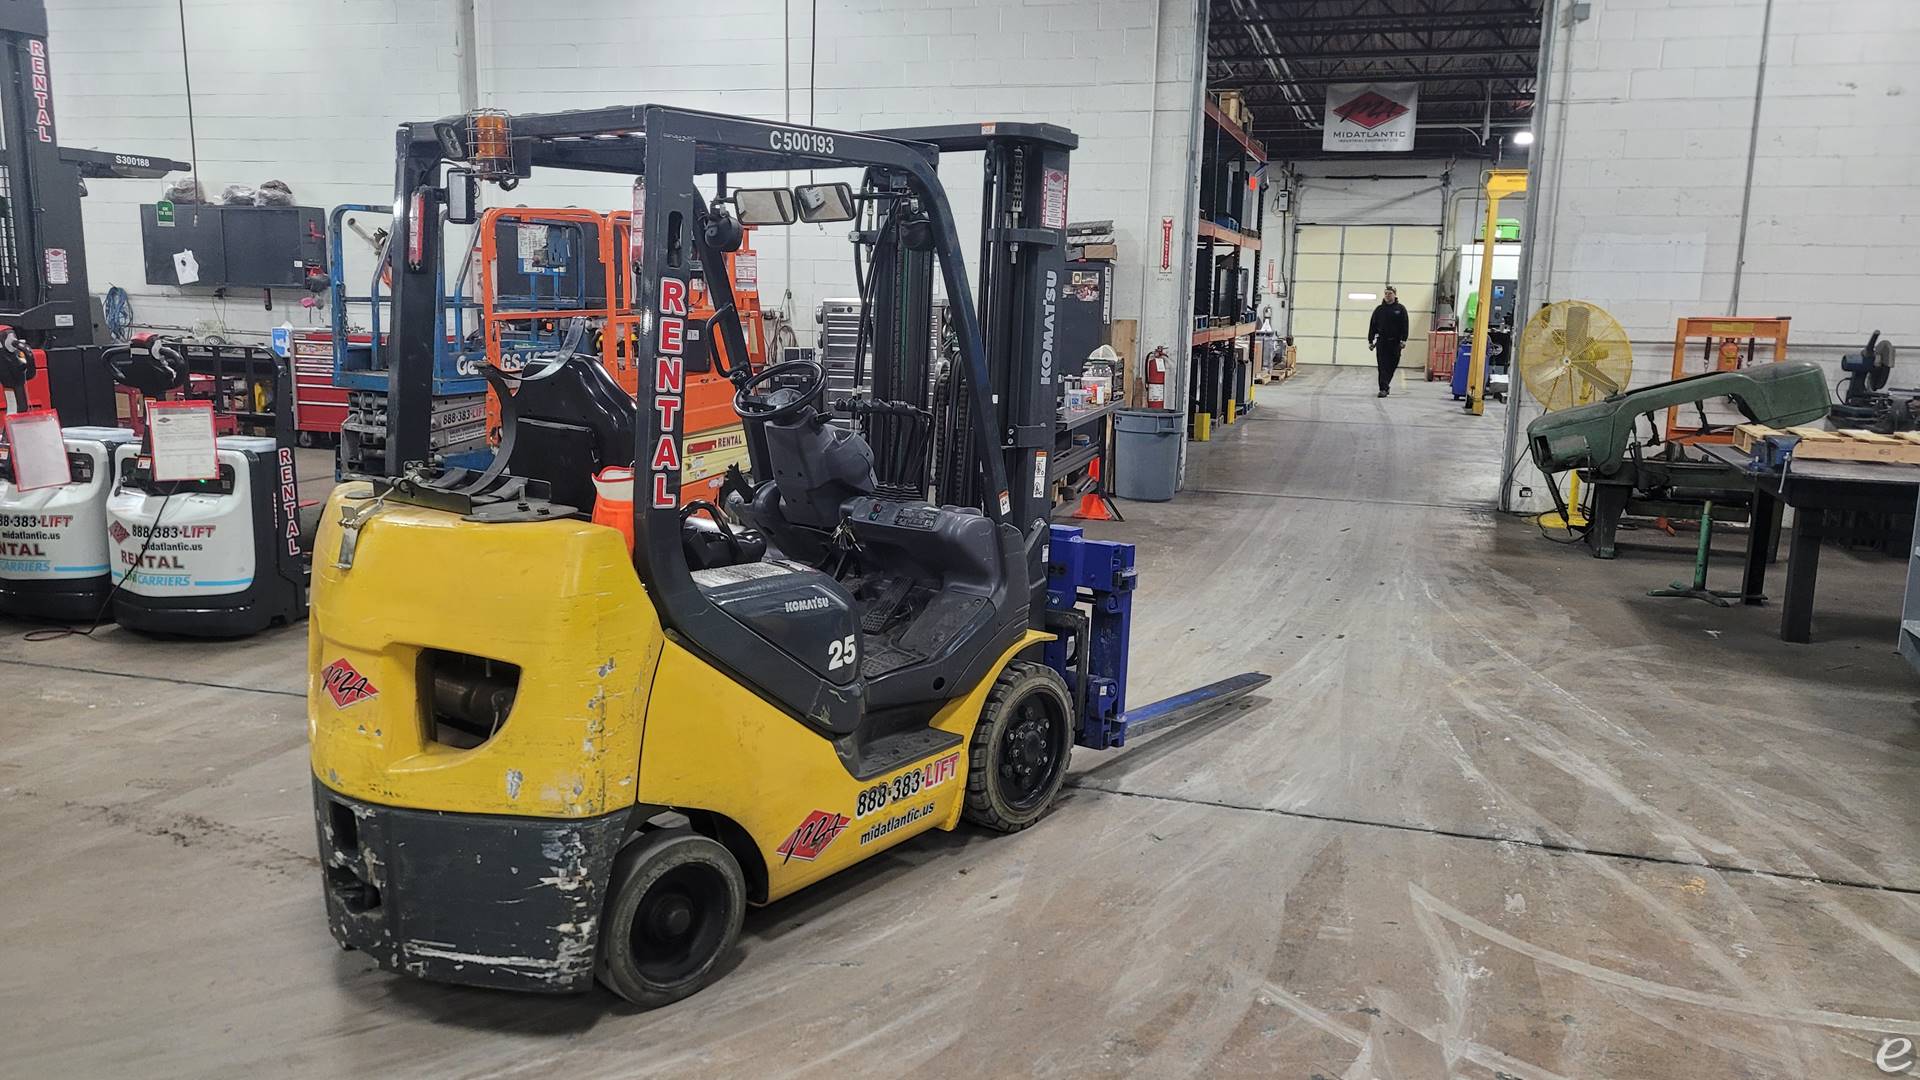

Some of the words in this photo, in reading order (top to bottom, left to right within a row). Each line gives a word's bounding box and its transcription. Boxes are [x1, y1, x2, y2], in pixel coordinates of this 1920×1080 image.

[29, 39, 52, 142] RENTAL
[770, 130, 835, 154] C500193
[1040, 270, 1058, 385] KOMATSU
[651, 277, 688, 510] RENTAL
[718, 434, 742, 448] RENTAL
[279, 447, 301, 556] RENTAL
[121, 550, 184, 569] RENTAL
[785, 596, 829, 613] KOMATSU
[828, 633, 856, 671] 25
[860, 801, 936, 846] midatlantic.us
